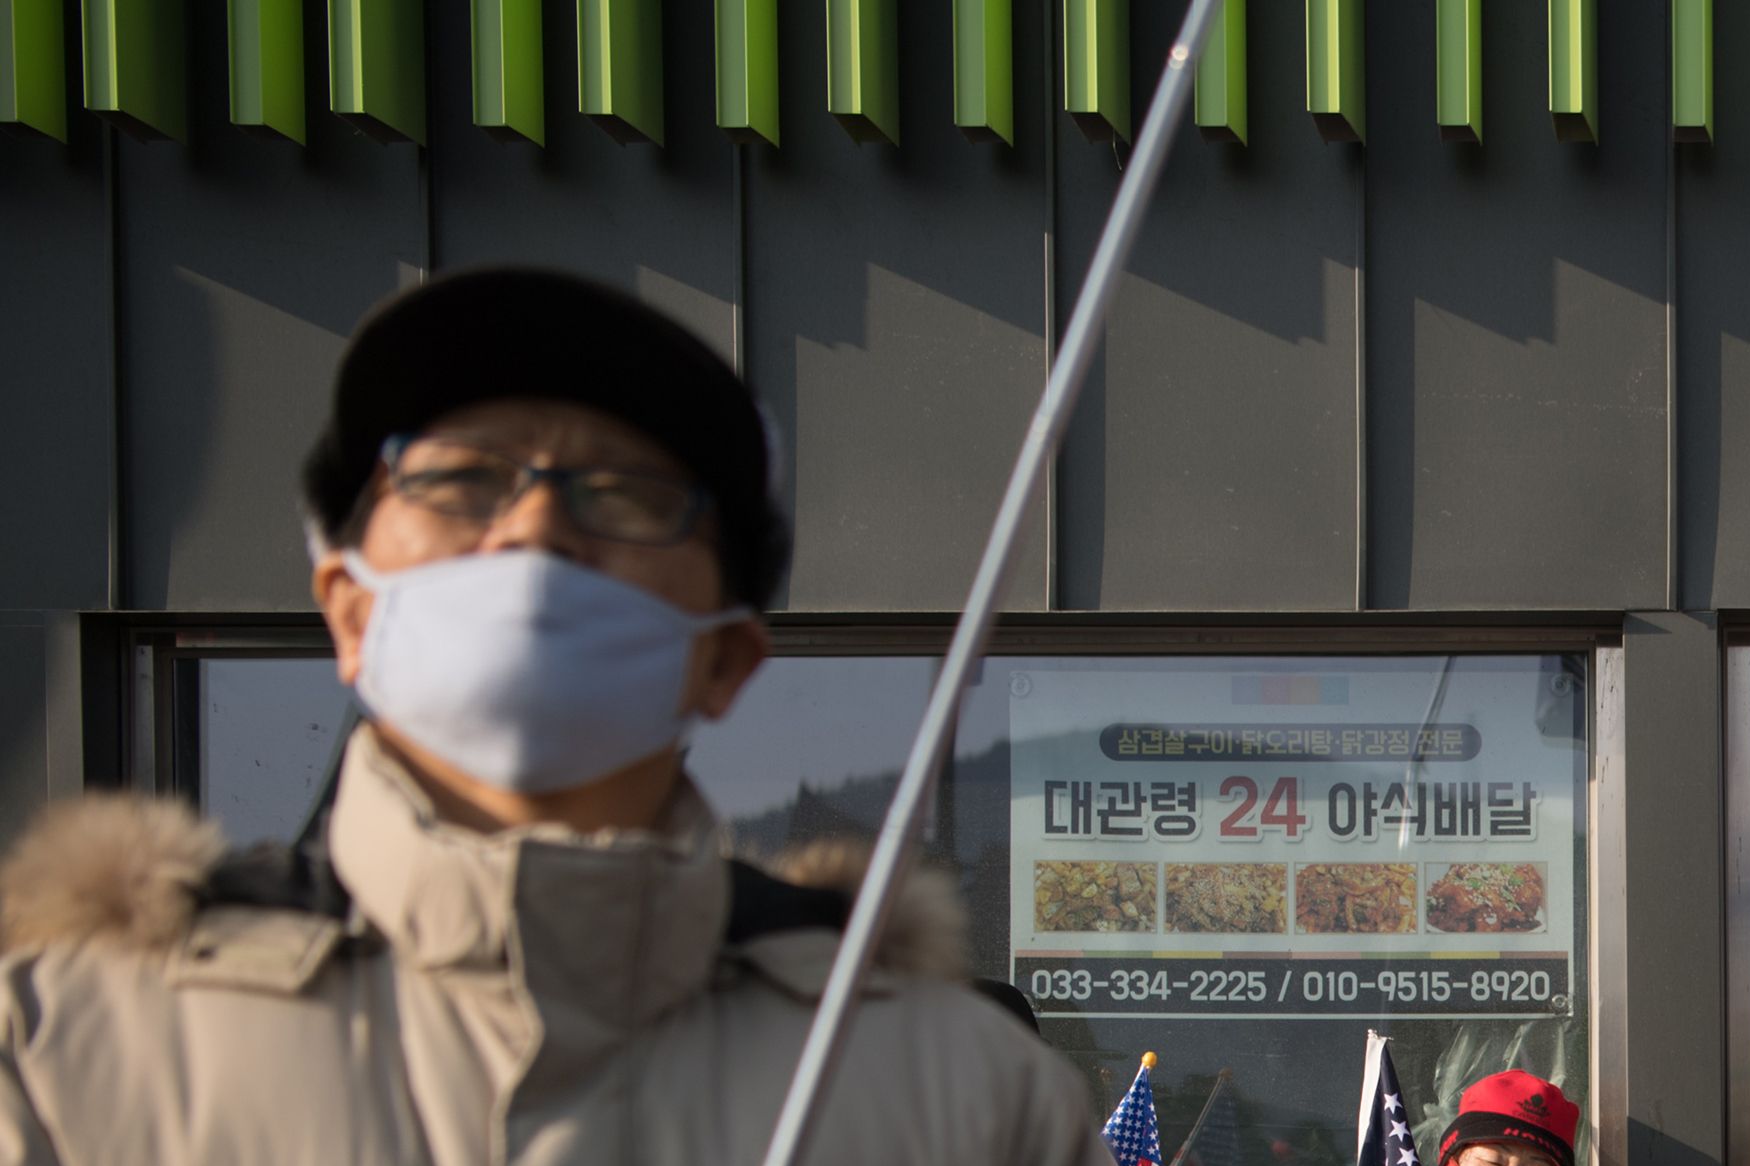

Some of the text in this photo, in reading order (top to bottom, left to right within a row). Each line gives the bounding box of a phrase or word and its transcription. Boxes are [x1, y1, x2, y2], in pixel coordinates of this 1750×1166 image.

[1418, 728, 1464, 757] 전문
[1043, 775, 1537, 838] 대관령 24 야식배달
[1031, 969, 1267, 1002] 033-334-2225
[1302, 969, 1551, 1002] 010-9515-8920
